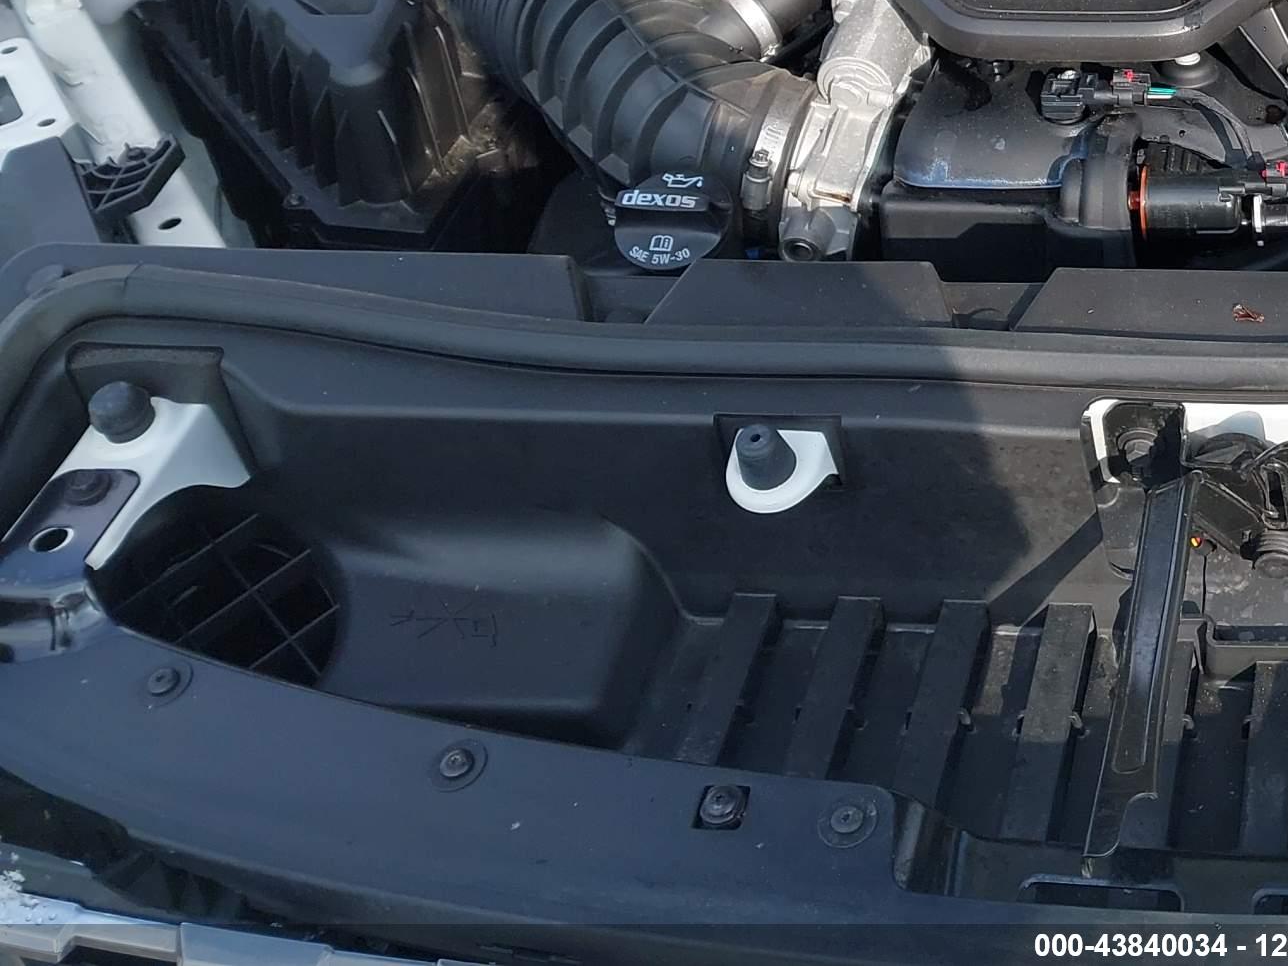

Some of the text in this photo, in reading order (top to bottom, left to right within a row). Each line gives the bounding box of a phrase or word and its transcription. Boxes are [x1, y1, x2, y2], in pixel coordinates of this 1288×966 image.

[621, 189, 700, 208] dexos
[629, 246, 691, 265] SAE 5W-30
